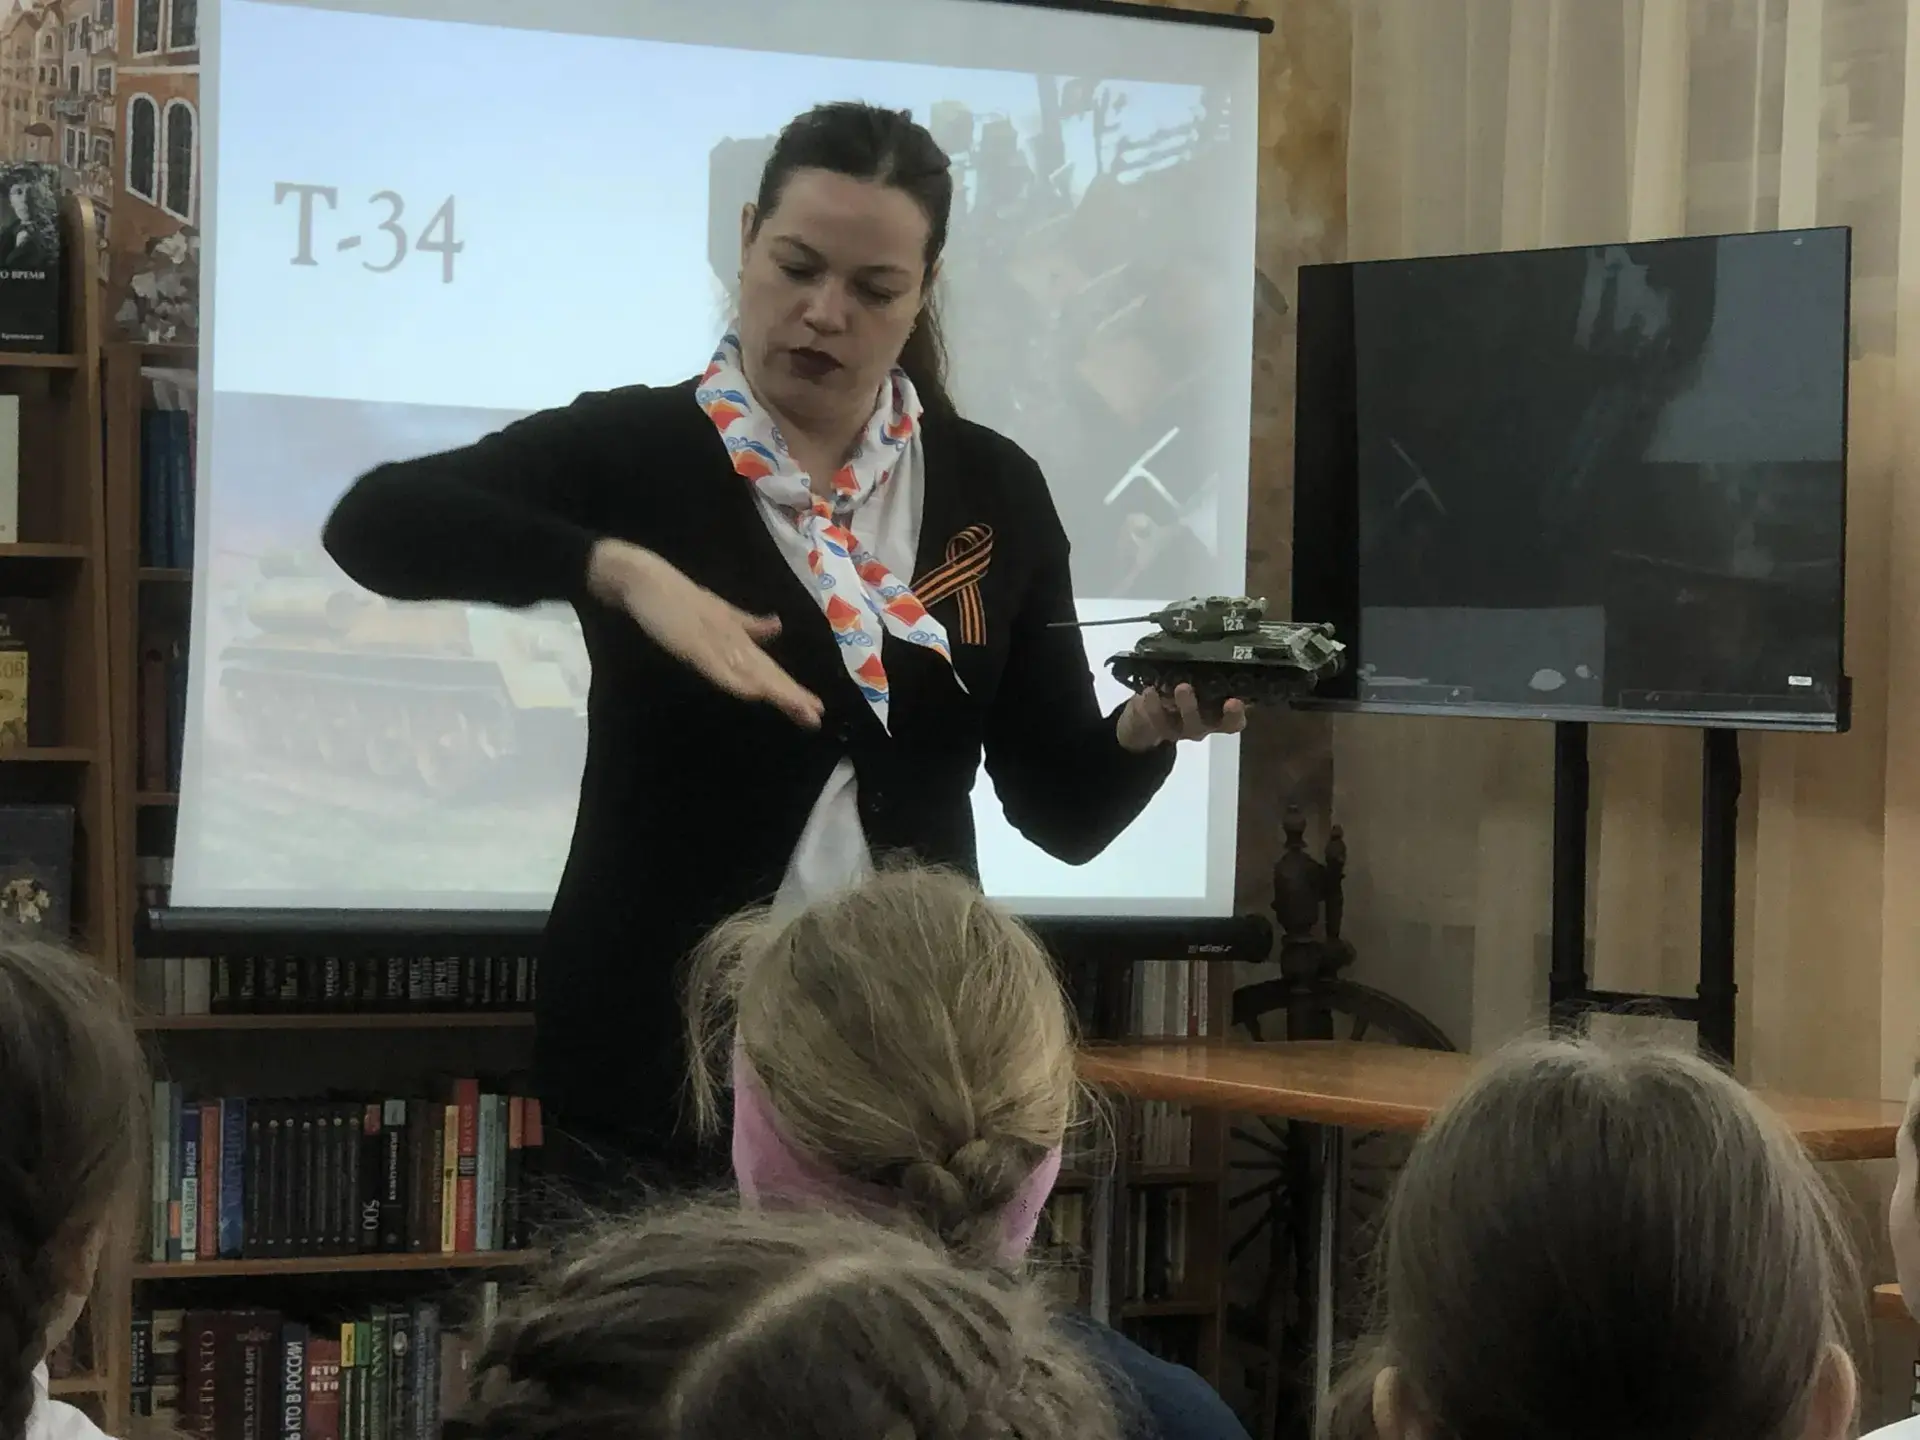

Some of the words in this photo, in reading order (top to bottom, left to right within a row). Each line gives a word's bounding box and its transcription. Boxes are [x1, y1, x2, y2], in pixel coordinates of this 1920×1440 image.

[273, 181, 465, 284] Т-34
[200, 1330, 216, 1371] КТО
[286, 1341, 303, 1391] РОССИИ
[311, 1366, 340, 1377] КТО
[286, 1394, 302, 1404] В
[310, 1381, 340, 1392] КТО
[286, 1405, 302, 1431] КТО
